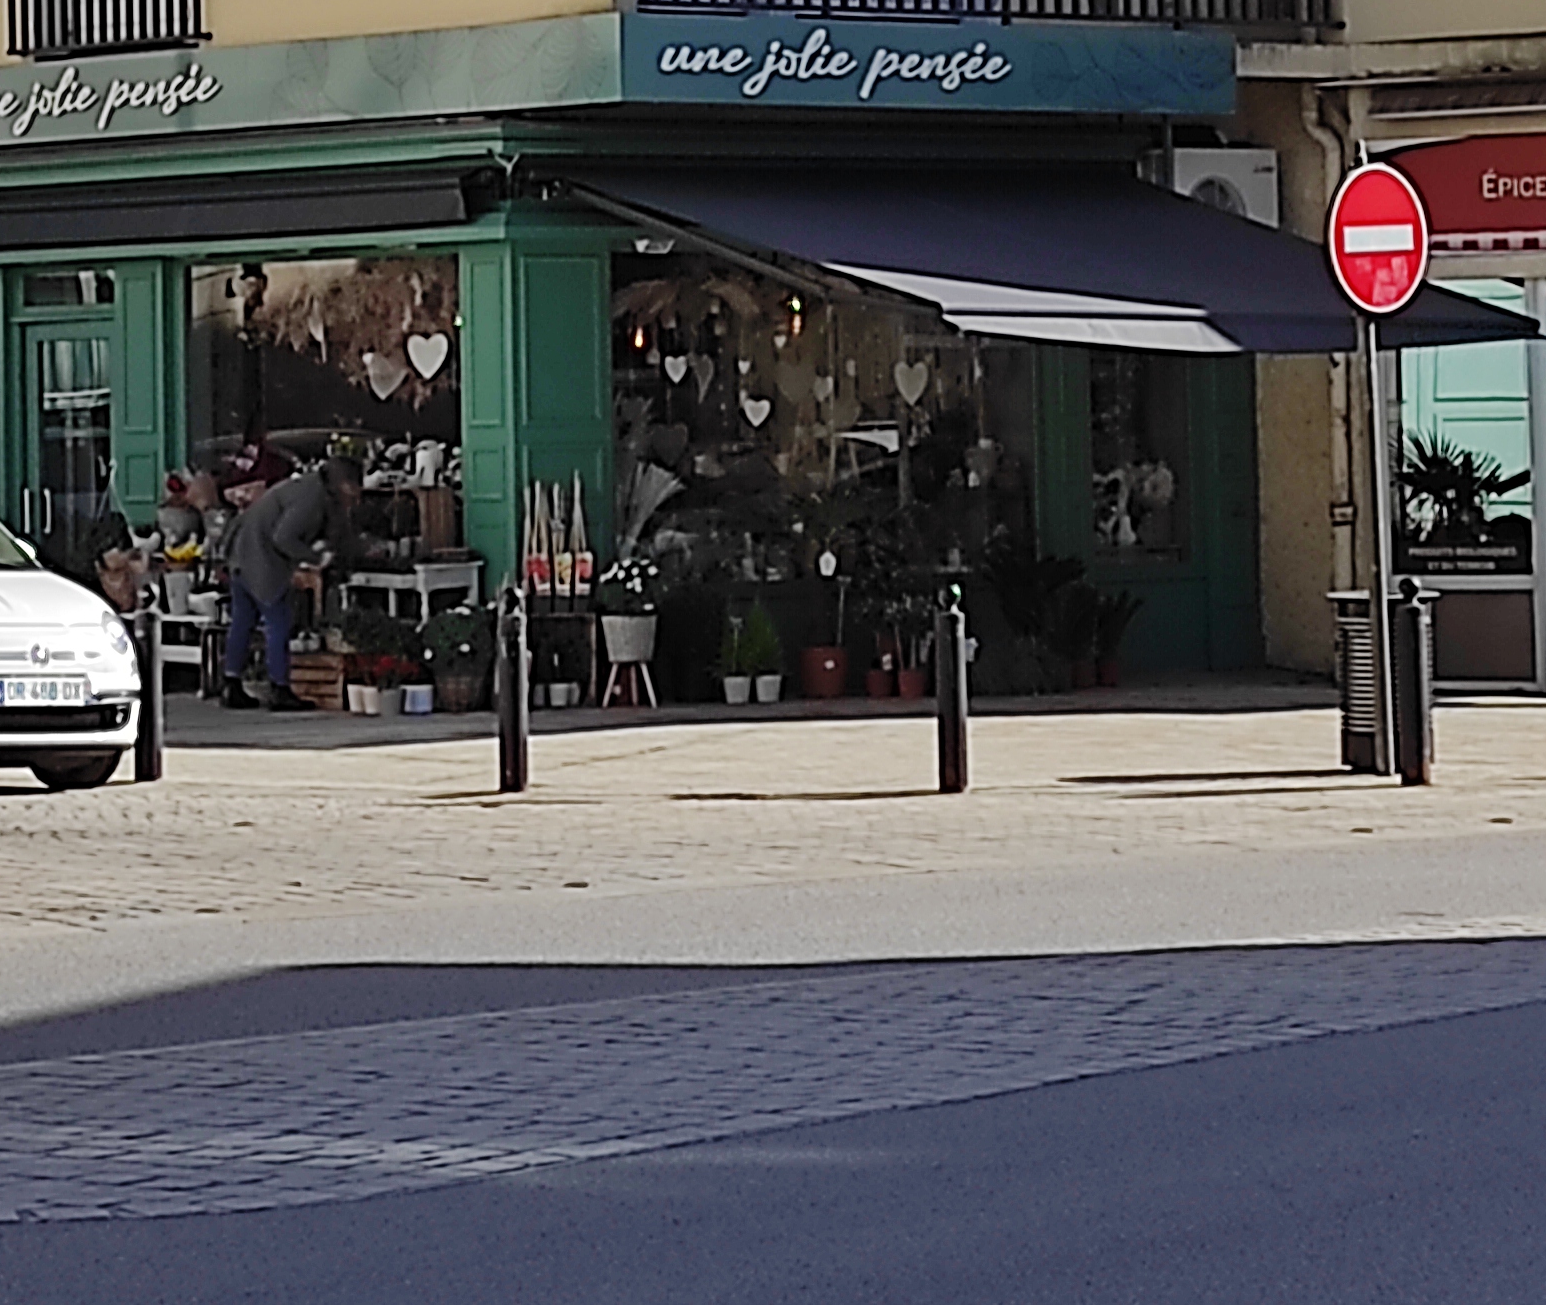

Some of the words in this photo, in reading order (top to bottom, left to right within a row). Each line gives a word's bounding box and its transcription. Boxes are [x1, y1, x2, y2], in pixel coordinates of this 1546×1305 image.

[12, 65, 99, 136] jolie
[97, 62, 222, 131] pensée
[659, 44, 753, 73] une
[742, 27, 857, 96] jolie
[858, 41, 1012, 99] pensée
